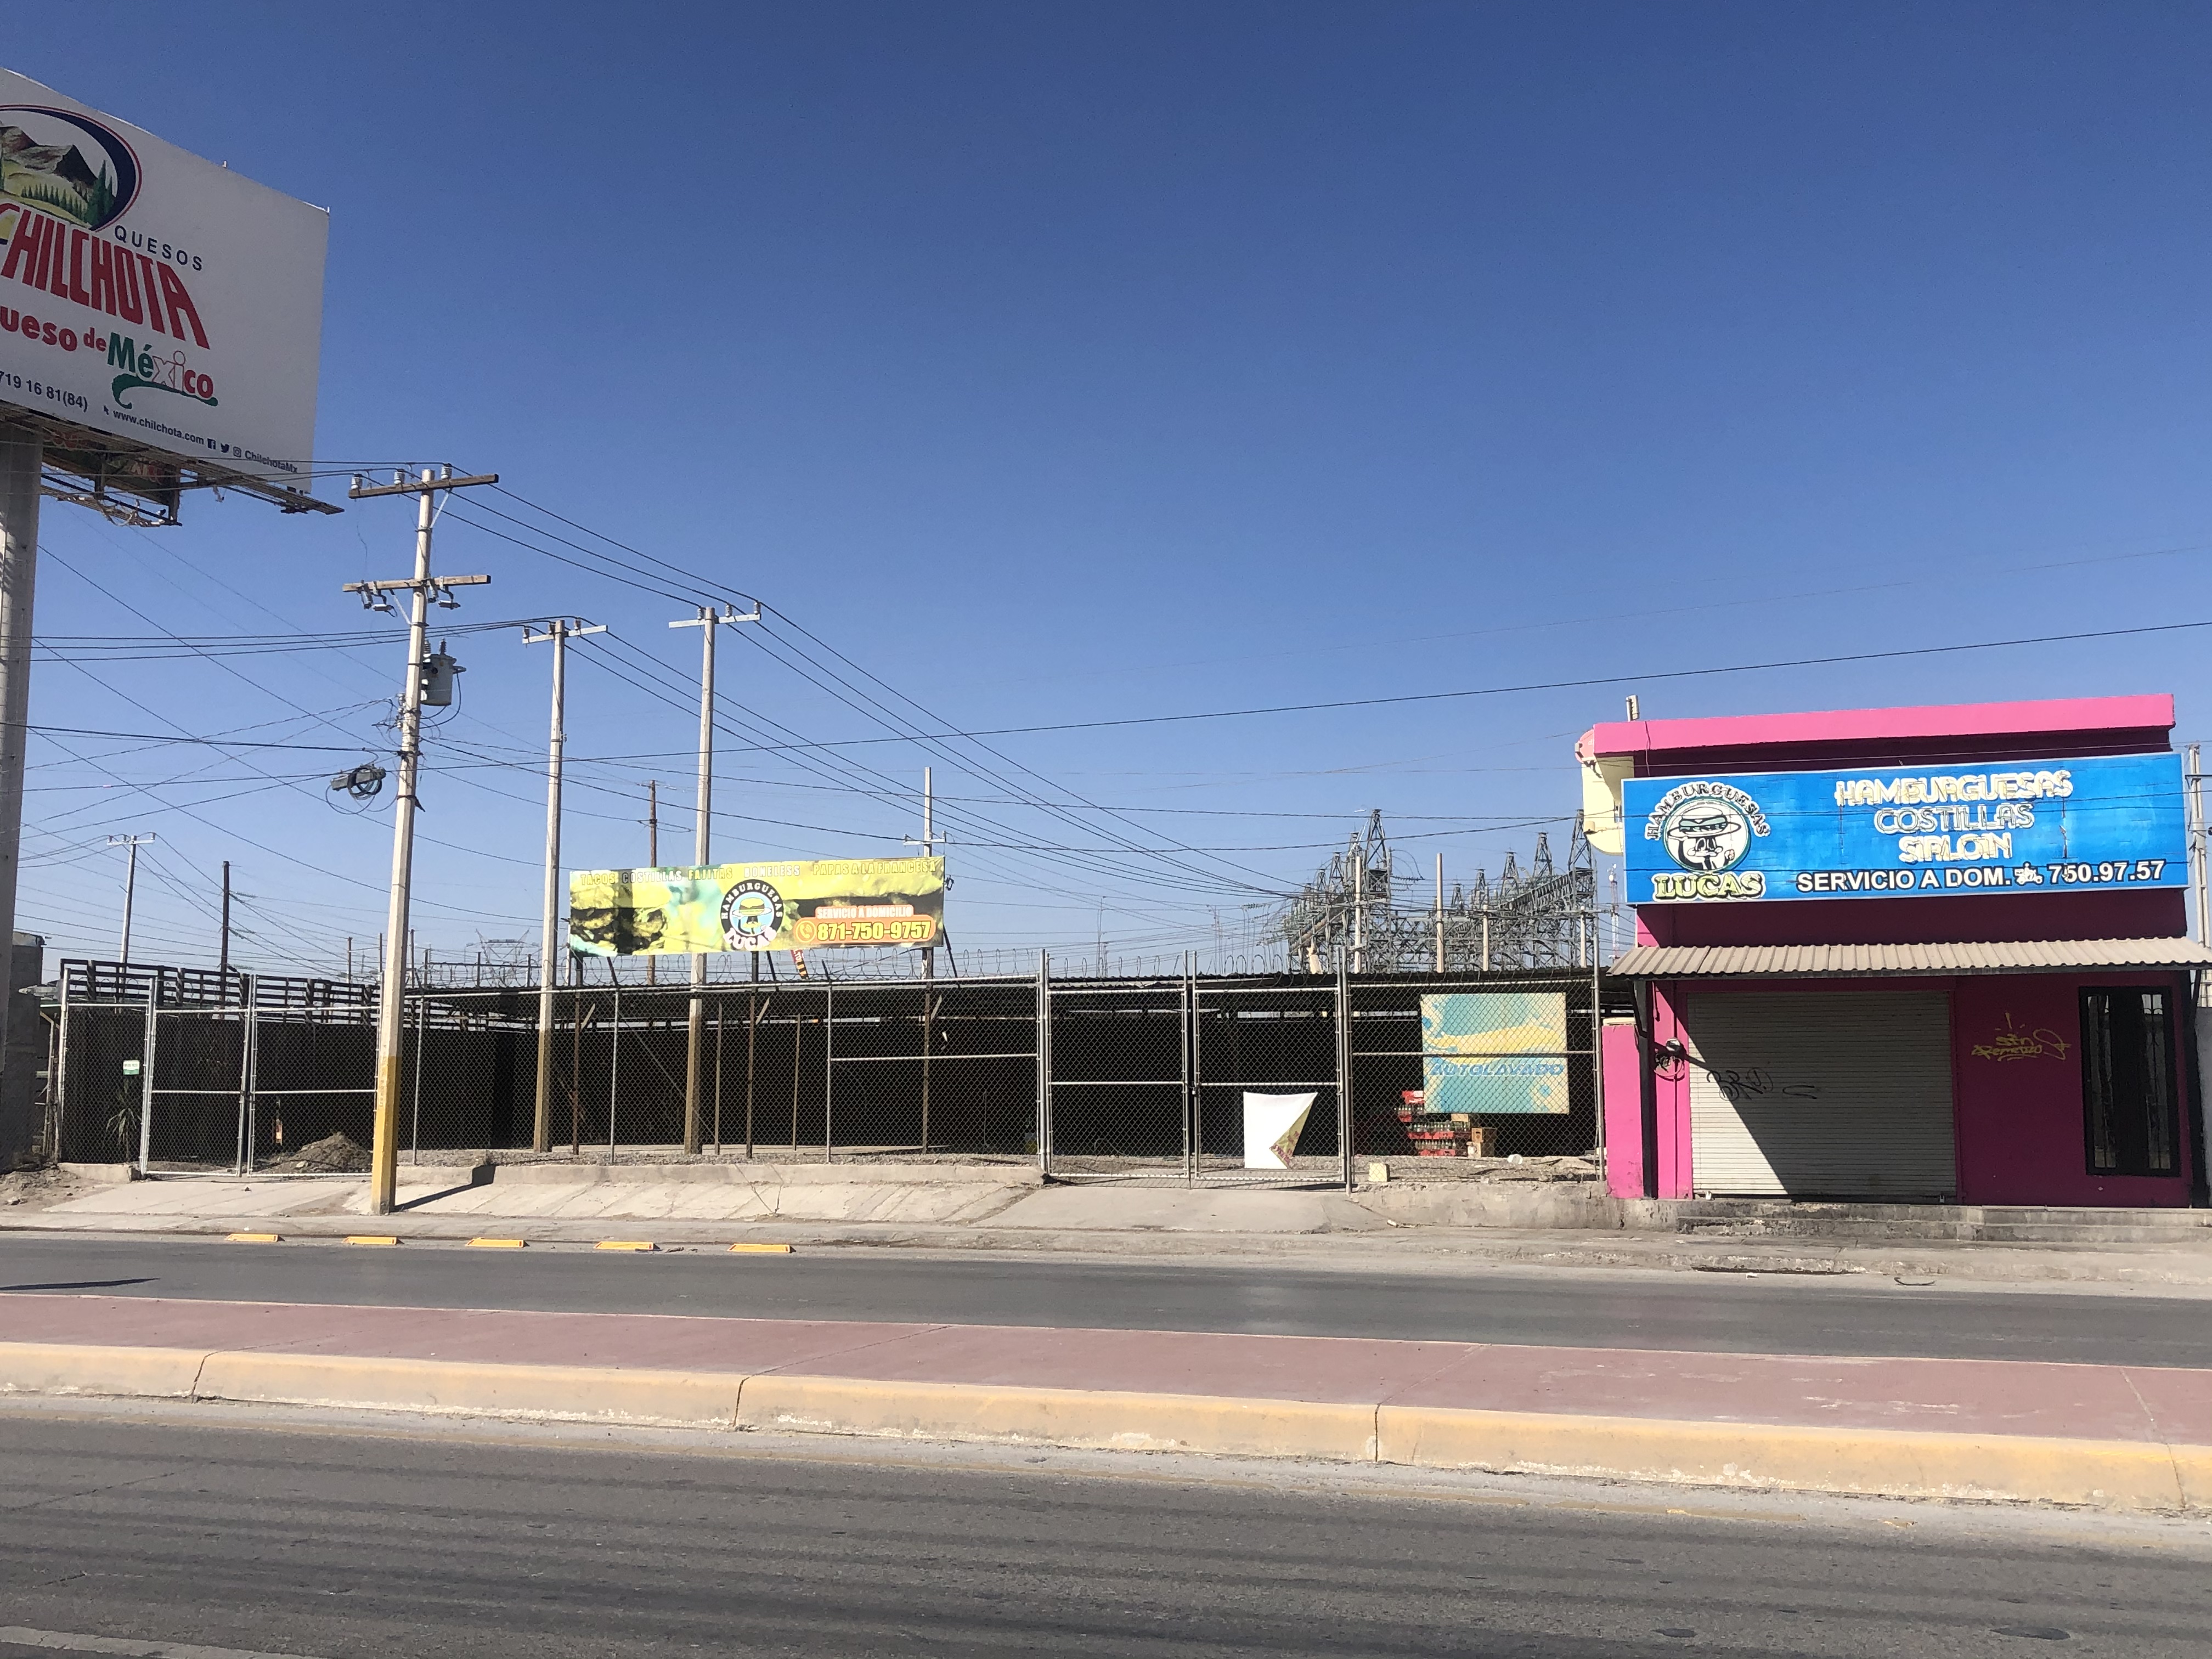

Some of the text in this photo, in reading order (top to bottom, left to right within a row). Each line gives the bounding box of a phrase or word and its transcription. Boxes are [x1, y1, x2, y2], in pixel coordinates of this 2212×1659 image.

[114, 225, 202, 271] QUESOS
[83, 327, 107, 352] de
[108, 332, 214, 399] México
[26, 380, 42, 395] 16
[47, 386, 88, 413] 81(84)
[113, 410, 204, 445] www.chilchota.com
[1834, 770, 2074, 807] HAMBURGUESAS
[1645, 782, 1771, 840] HAMBURGUESAS
[1874, 803, 2034, 834] COSTILLAS
[1899, 832, 2013, 863] SIRLOIN
[580, 861, 936, 885] TACOS COSTILLAS FAJITAS BONELESS PAPAS A LA FRANCESA
[1654, 872, 1763, 900] LUCAS
[1797, 860, 2166, 892] SERVICIO A DOM. 750.97.57
[721, 882, 783, 920] HAMBURGUESAS
[816, 906, 912, 919] SERVICIO A DOMICILIO
[816, 921, 932, 941] 871-750-9757
[1429, 1063, 1565, 1076] AUTOLAVADO
